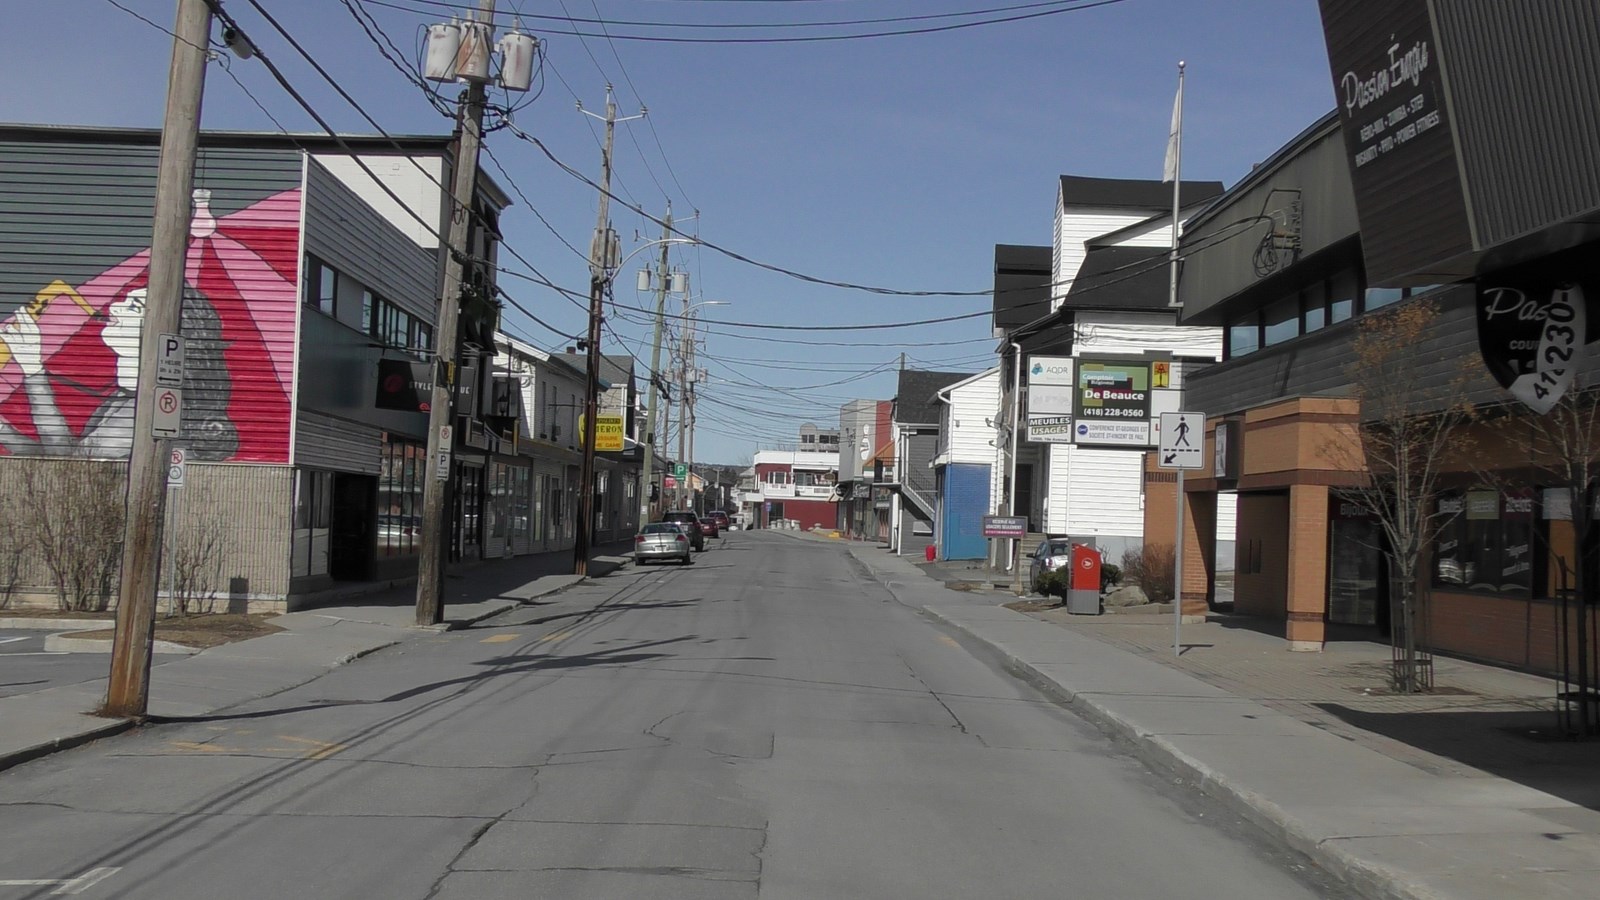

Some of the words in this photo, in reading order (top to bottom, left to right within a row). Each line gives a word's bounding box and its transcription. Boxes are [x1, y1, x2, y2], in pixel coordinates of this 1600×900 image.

[1341, 71, 1390, 118] Passion
[1410, 93, 1424, 113] STEP
[1416, 110, 1440, 134] FITNESS
[166, 339, 178, 357] P
[1046, 366, 1068, 375] AQDR
[1082, 373, 1114, 382] Comptoir
[1084, 390, 1101, 400] De
[1103, 391, 1144, 401] Beauce
[1083, 408, 1103, 417] (418)
[1104, 408, 1144, 417] 228-0560
[1030, 417, 1070, 427] MEUBLES
[1032, 426, 1067, 435] USAGÉS
[440, 455, 447, 465] P
[677, 465, 685, 475] P
